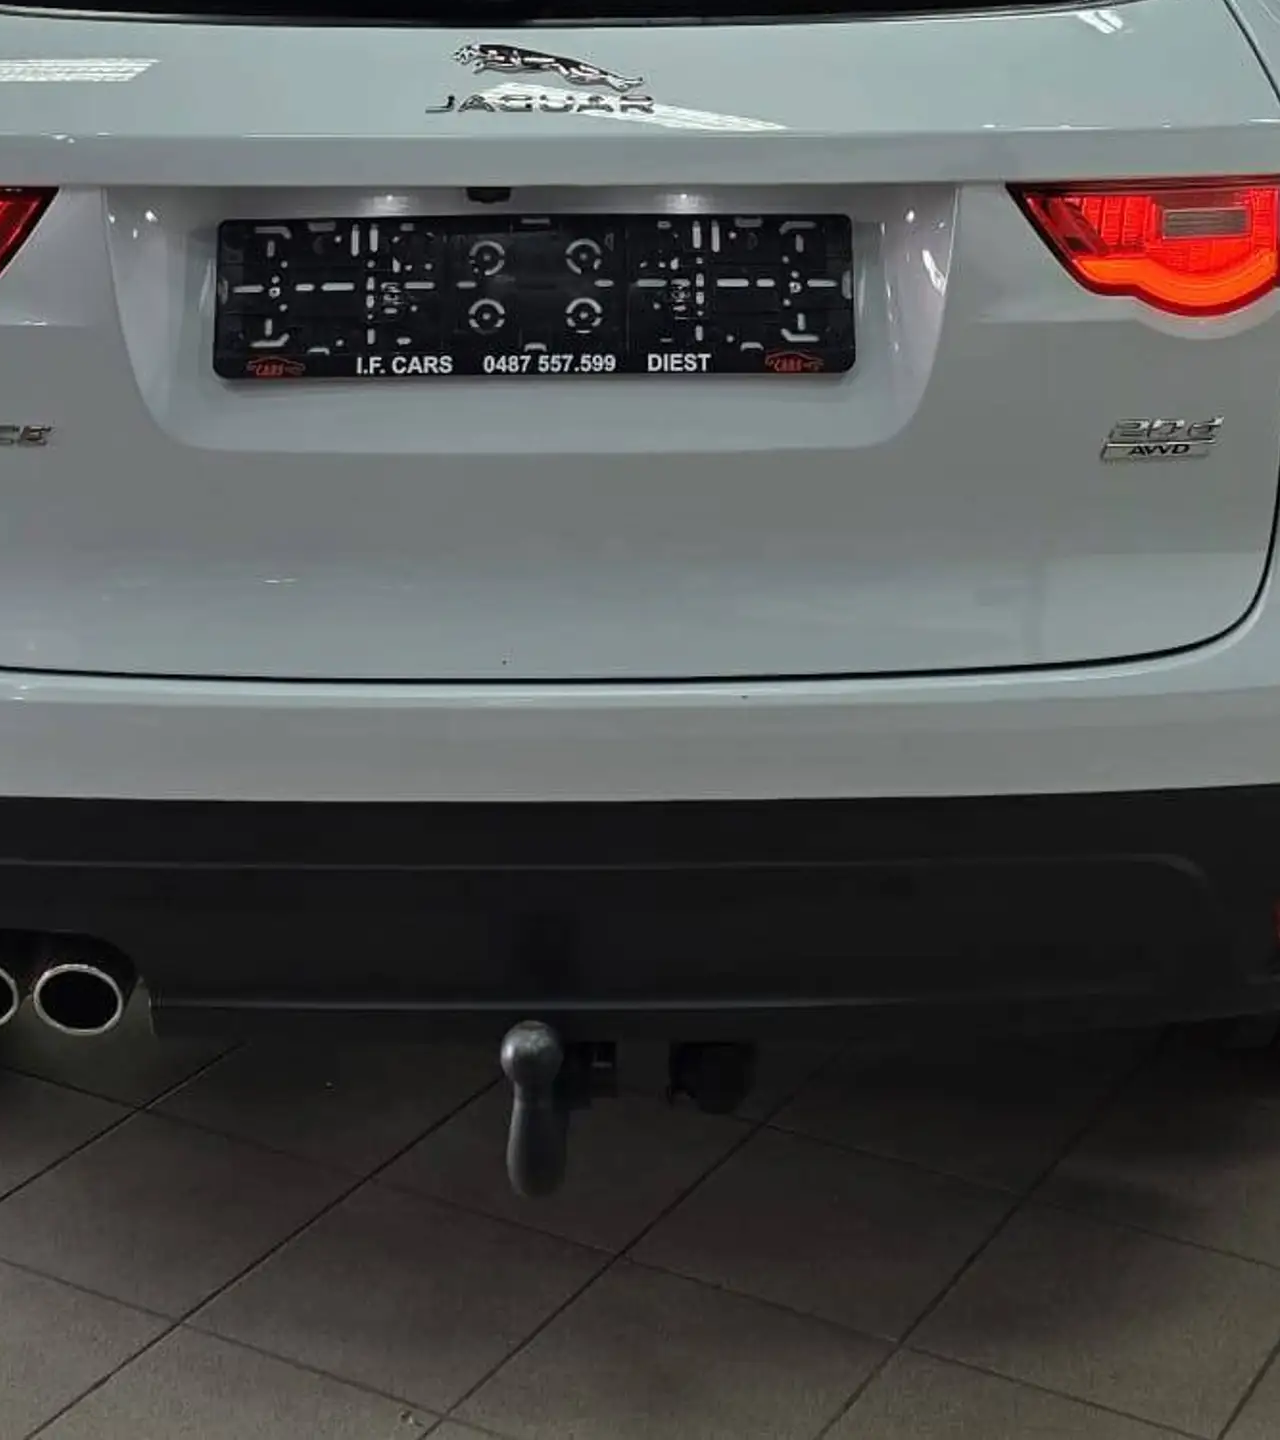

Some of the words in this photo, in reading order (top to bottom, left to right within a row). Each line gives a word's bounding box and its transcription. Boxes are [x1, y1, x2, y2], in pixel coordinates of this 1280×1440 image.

[425, 94, 655, 114] JAGUAR
[356, 357, 386, 375] I.F.
[392, 355, 453, 375] CARS
[483, 355, 531, 373] 0487
[538, 354, 616, 372] 557.599
[647, 353, 711, 372] DIEST
[1128, 443, 1191, 456] AWD
